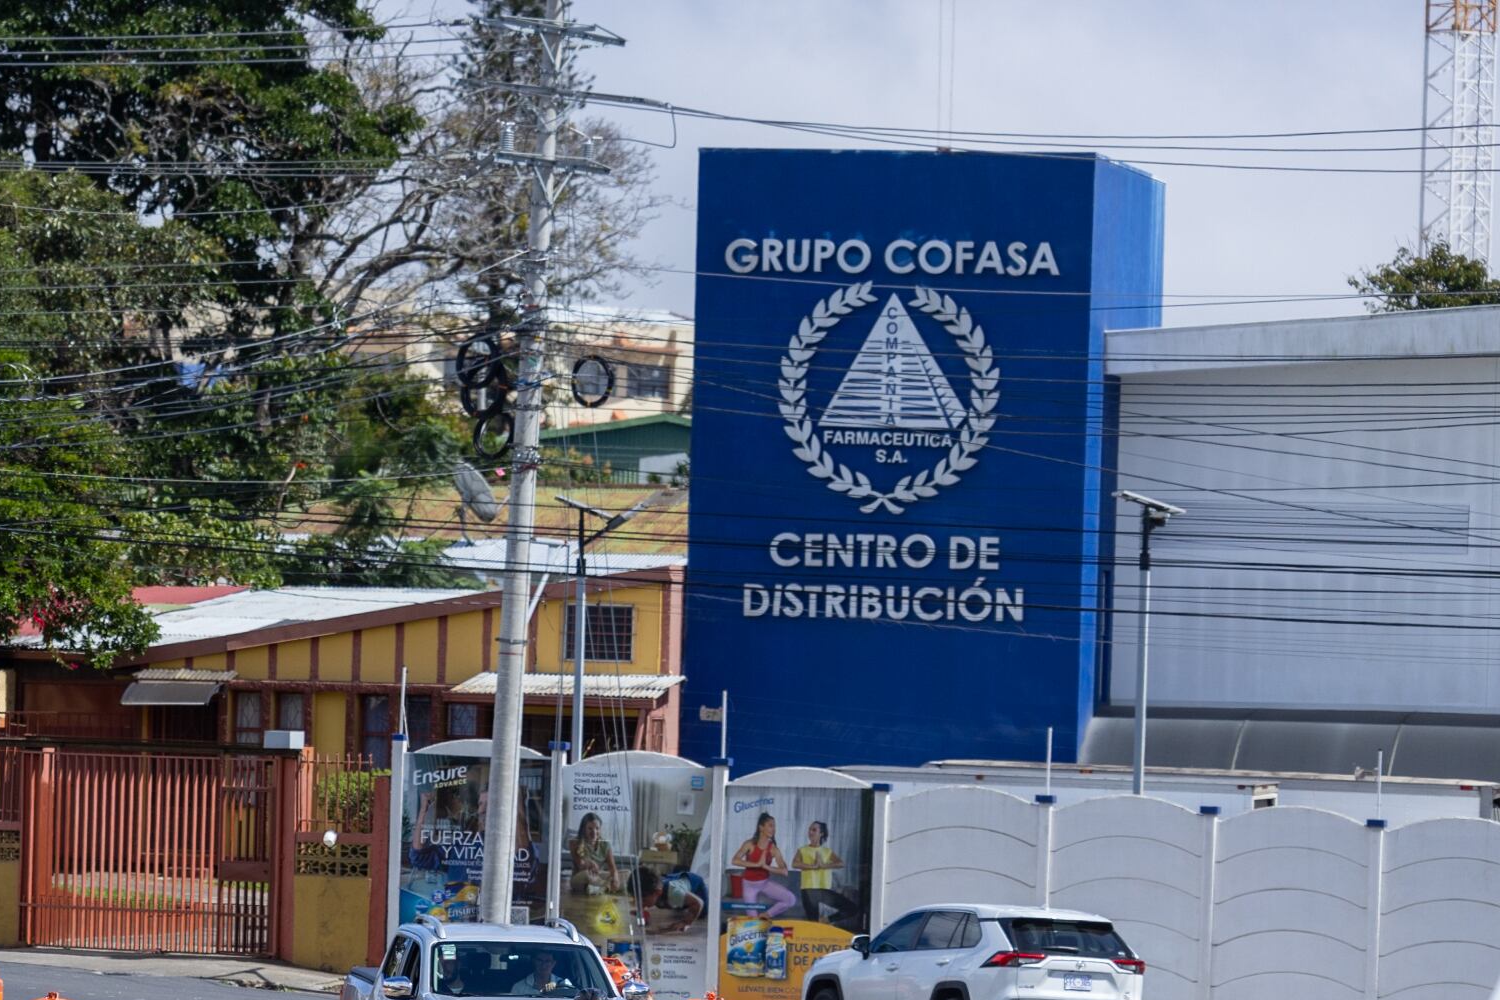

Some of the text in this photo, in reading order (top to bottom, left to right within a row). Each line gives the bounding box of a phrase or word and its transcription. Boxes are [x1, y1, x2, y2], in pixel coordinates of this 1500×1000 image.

[725, 238, 1060, 276] GRUPO COFASA
[823, 430, 953, 448] FARMACEUTICA
[875, 449, 908, 464] S.A.
[769, 532, 1000, 571] CENTRO DE
[743, 577, 1024, 622] DISTRIBUCIÓN
[412, 765, 468, 786] Ensure
[434, 778, 468, 789] ADVANCE
[573, 784, 611, 796] Similac
[733, 796, 775, 814] Glucerna
[420, 830, 484, 846] FUERZA
[442, 846, 452, 859] Y
[790, 943, 809, 953] TUS
[793, 956, 808, 965] DE
